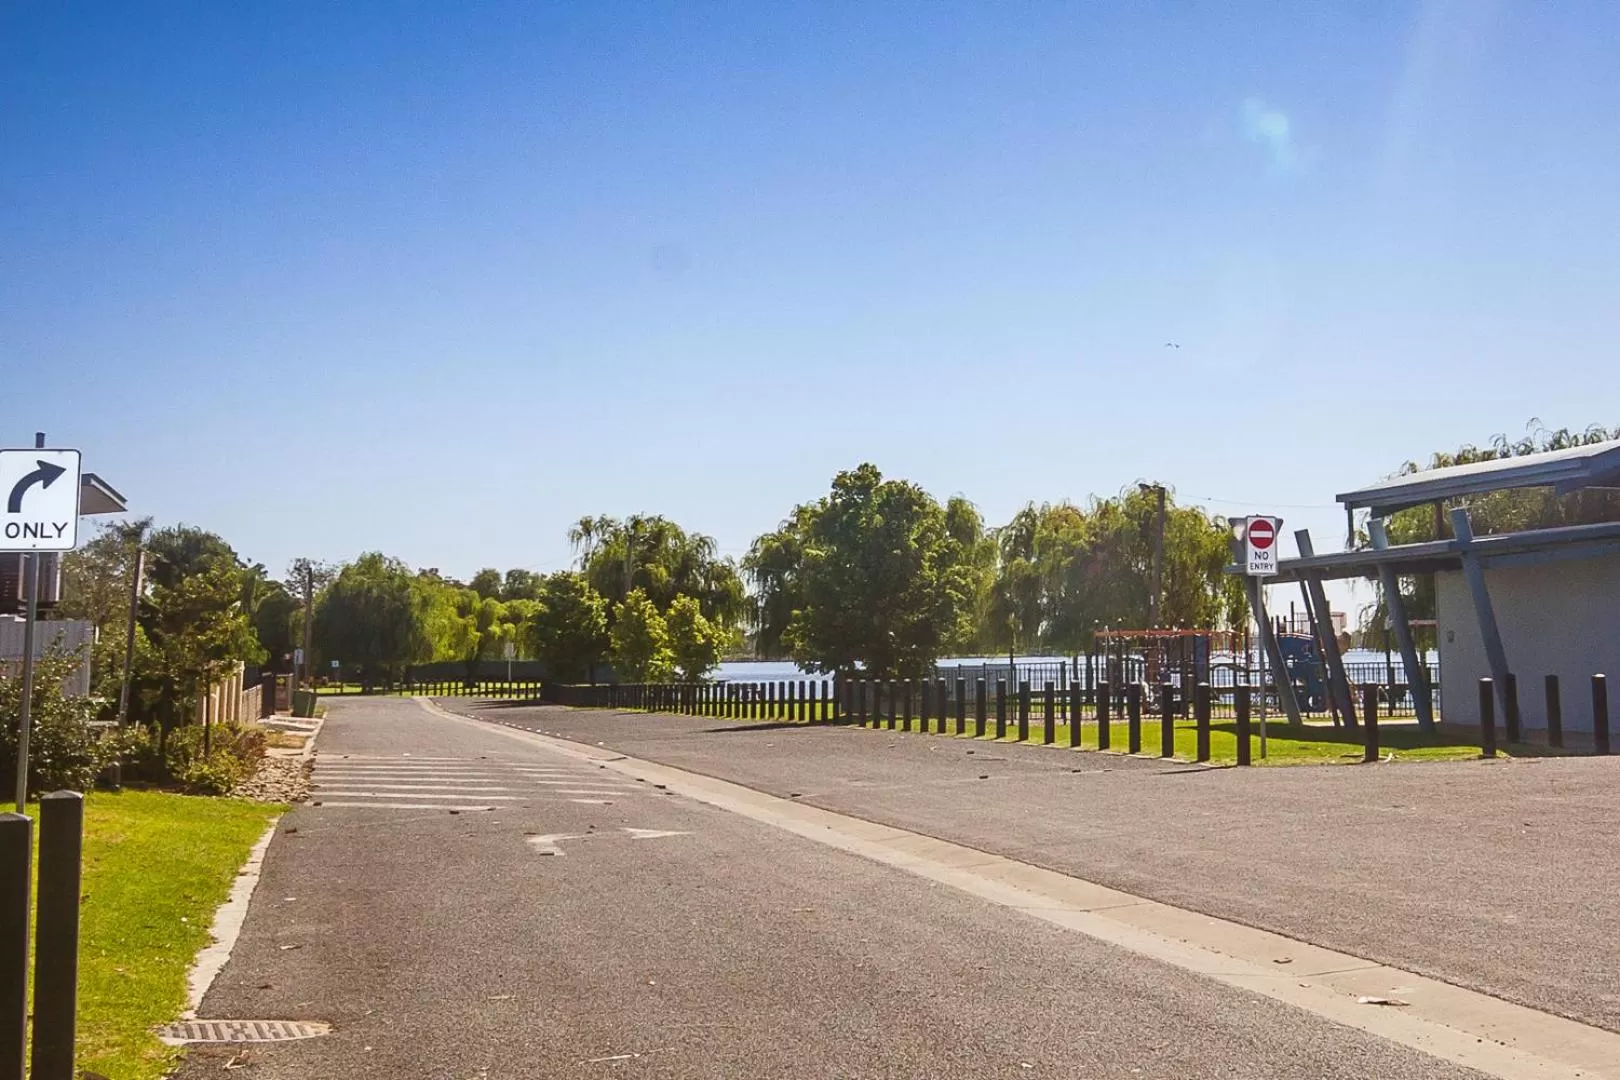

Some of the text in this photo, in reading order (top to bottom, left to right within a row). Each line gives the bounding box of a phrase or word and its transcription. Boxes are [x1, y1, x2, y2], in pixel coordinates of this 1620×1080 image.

[5, 522, 68, 539] ONLY
[1254, 551, 1269, 561] NO
[1249, 562, 1274, 571] ENTRY
